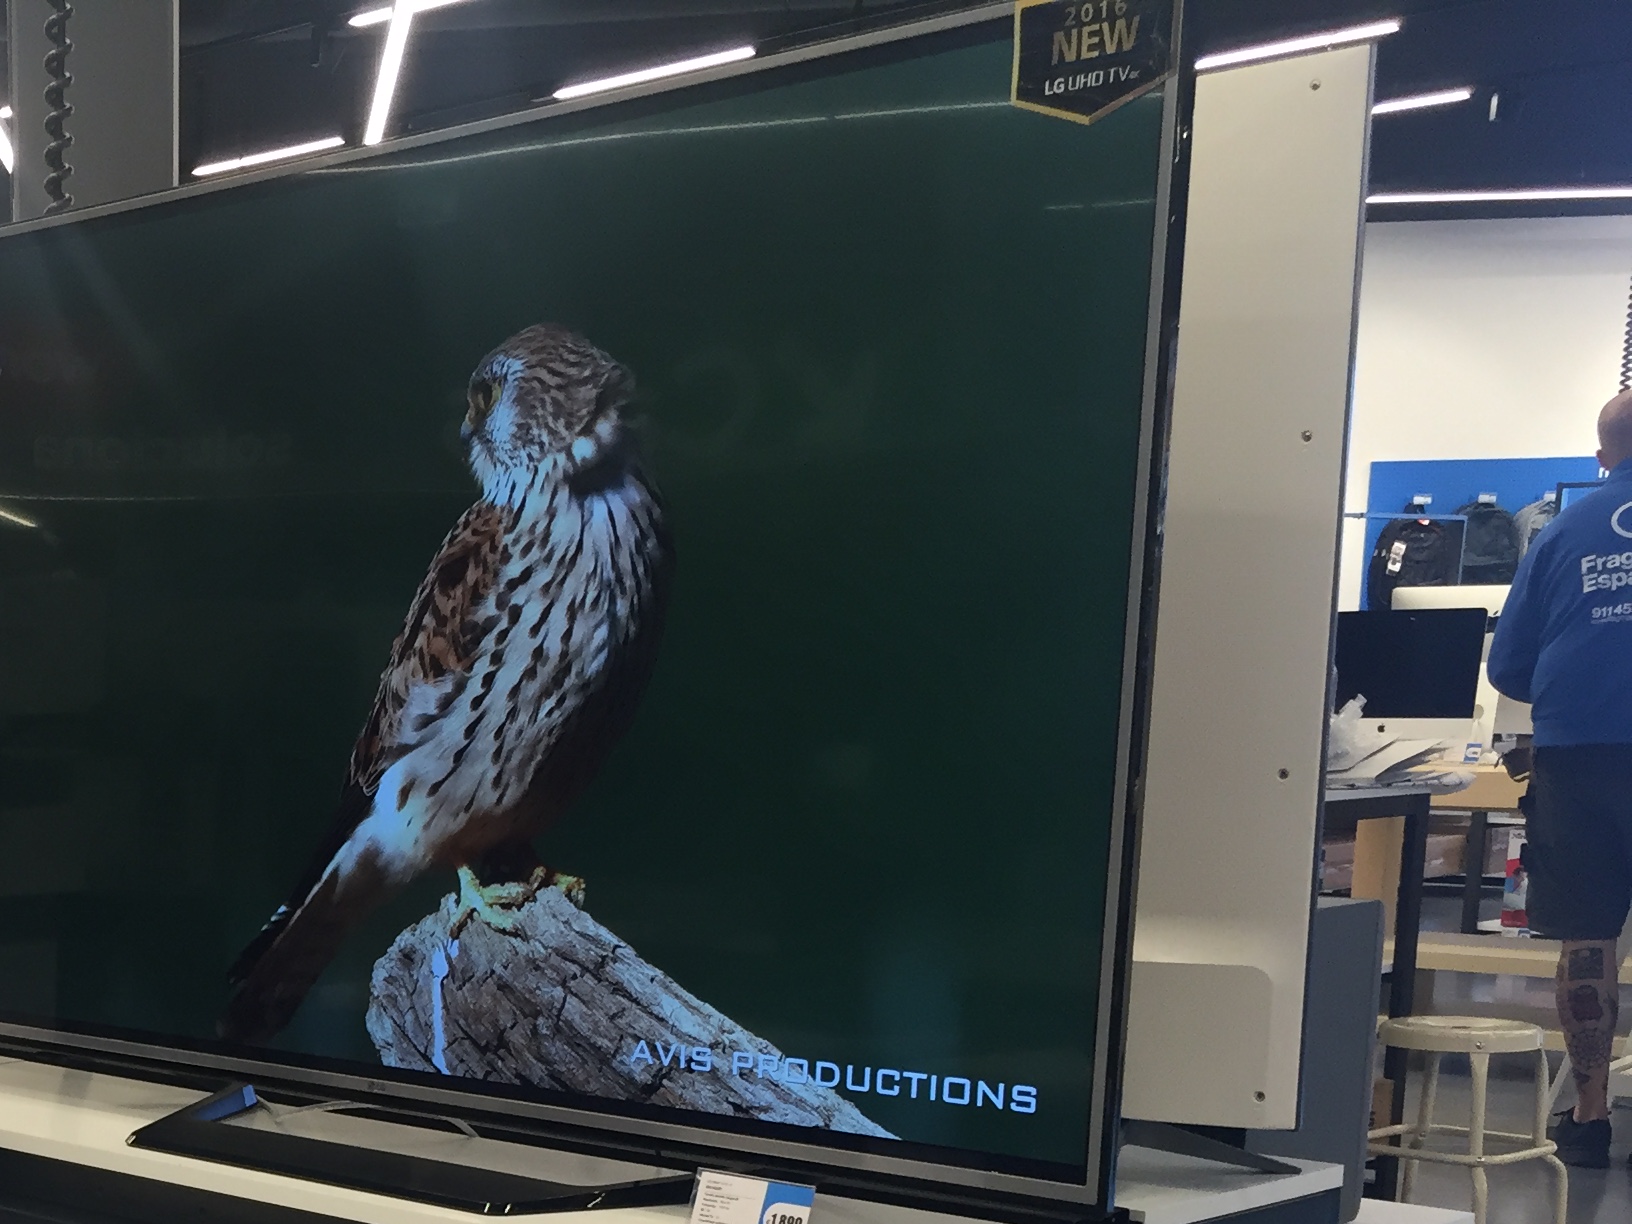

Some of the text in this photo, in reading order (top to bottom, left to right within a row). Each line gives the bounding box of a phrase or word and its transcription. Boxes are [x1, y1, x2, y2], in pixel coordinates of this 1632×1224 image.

[1064, 0, 1127, 26] 2016
[1051, 15, 1140, 66] NEW
[1044, 77, 1065, 96] LG
[1068, 70, 1103, 91] UHD
[1109, 65, 1130, 84] TV
[630, 1039, 1038, 1115] AVIS PRODUCTIONS
